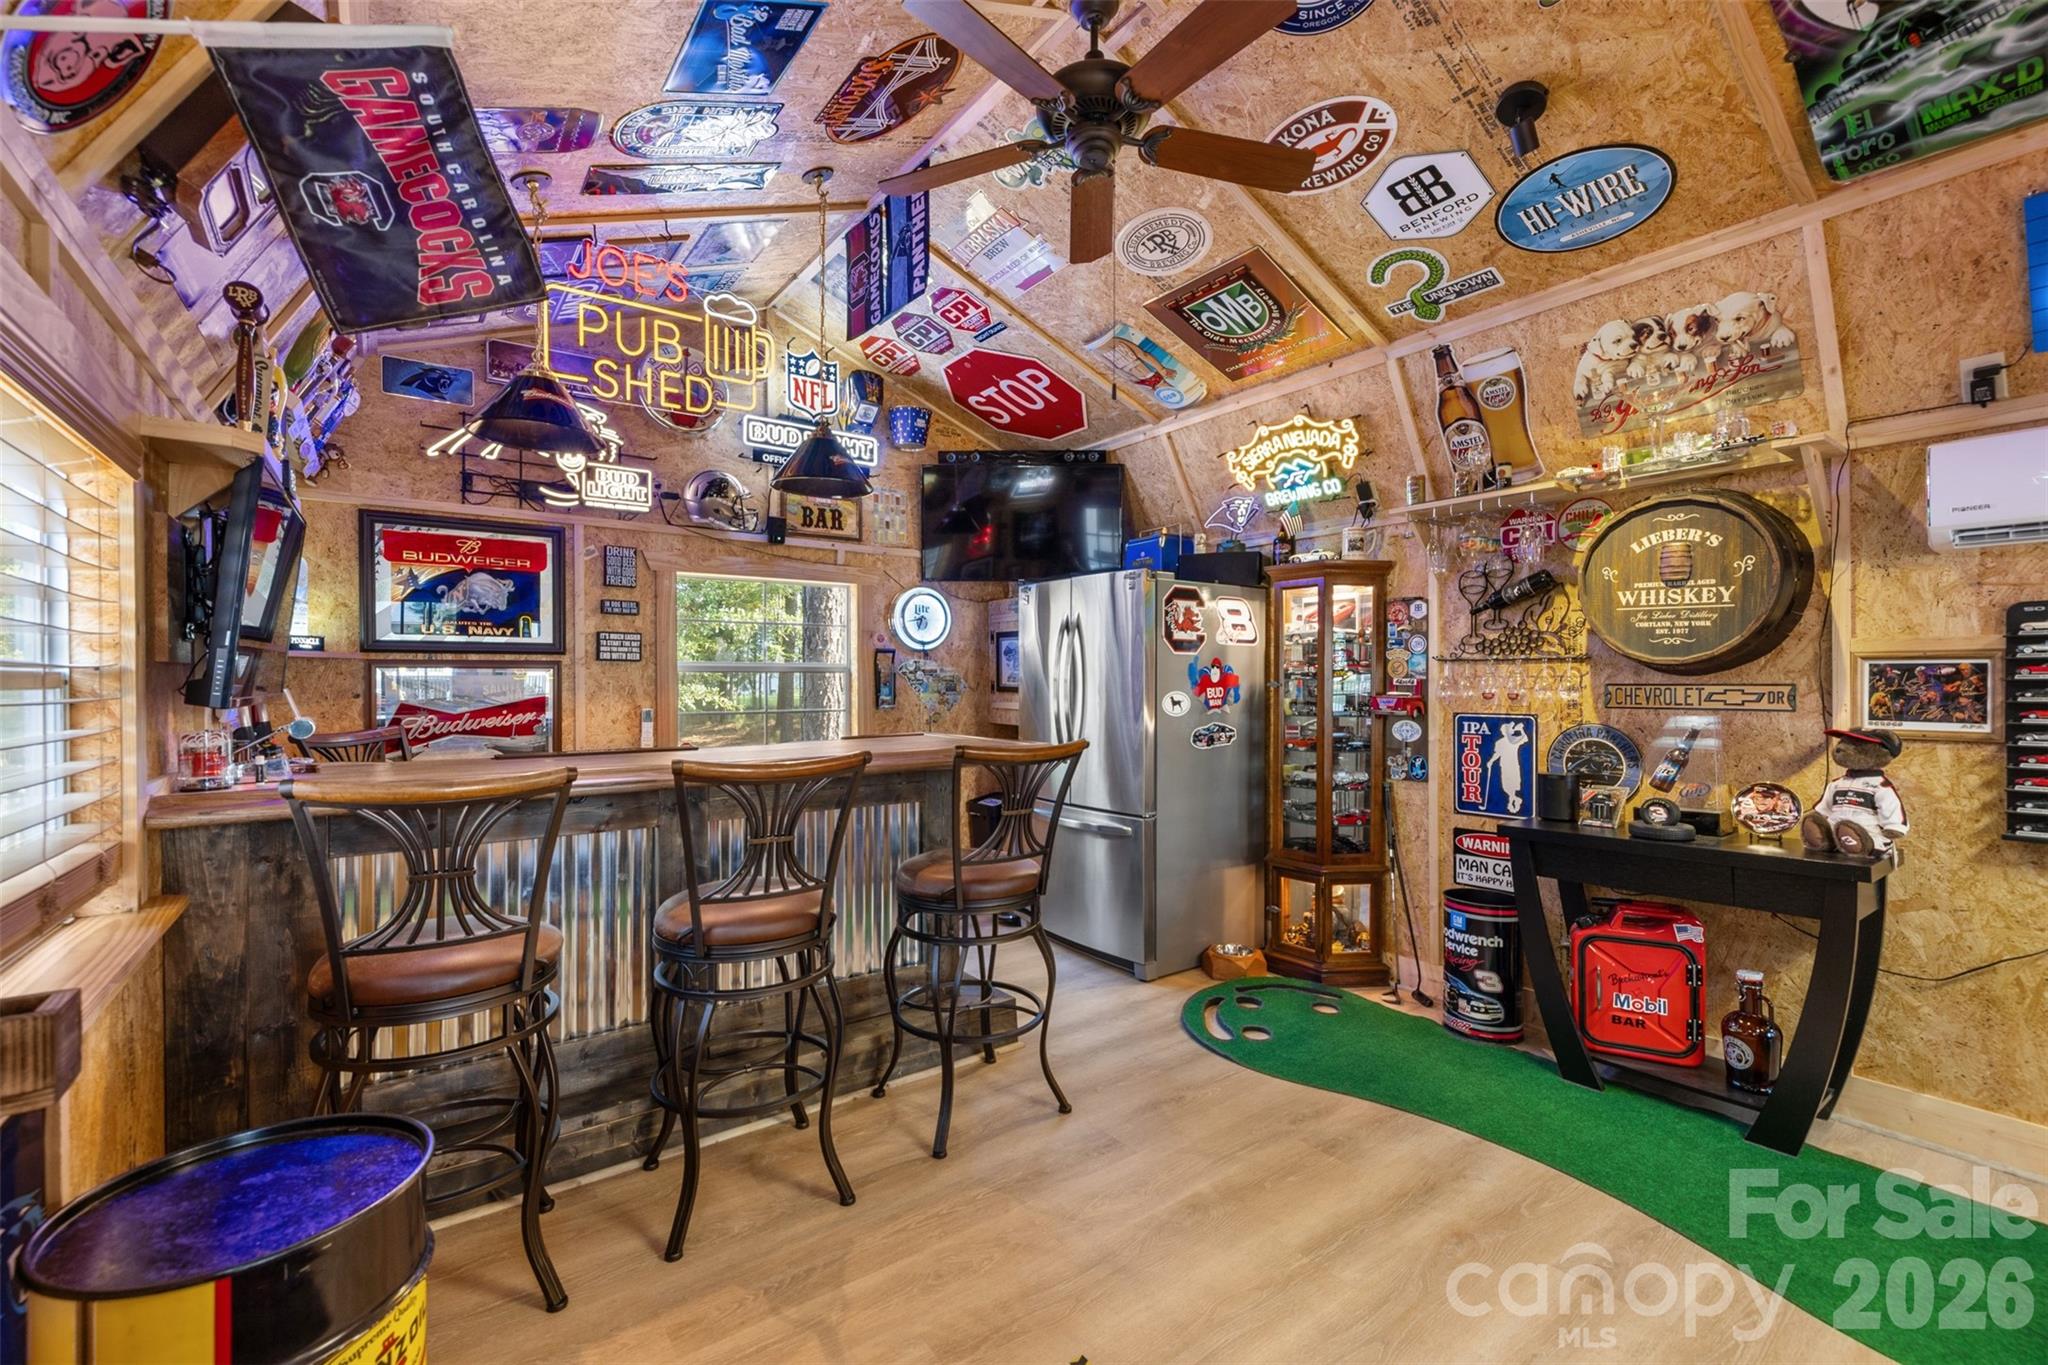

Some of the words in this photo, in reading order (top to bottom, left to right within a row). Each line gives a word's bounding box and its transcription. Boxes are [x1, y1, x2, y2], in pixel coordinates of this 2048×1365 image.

[1298, 1, 1346, 20] SINCE
[1302, 14, 1340, 28] OREGON
[1918, 56, 2046, 125] MAX-D
[1278, 108, 1337, 148] KONA
[412, 72, 453, 153] SOUTH
[446, 163, 512, 286] CAROLINA
[1301, 154, 1367, 188] REWING
[320, 67, 495, 306] GAMECOCKS
[1517, 164, 1648, 236] HI-WIRE
[1400, 193, 1479, 233] BENFORD
[1415, 206, 1473, 234] BREWING
[983, 238, 1010, 261] BREW
[567, 239, 689, 302] JOE'S
[869, 212, 882, 326] GAMECOCKS
[1424, 271, 1495, 302] UNKNOWN
[939, 296, 984, 324] CPI
[1200, 292, 1263, 335] OMB
[1391, 301, 1416, 315] THE
[578, 302, 684, 365] PUB
[902, 321, 945, 350] CPI
[1203, 331, 1226, 343] Olde
[871, 345, 909, 368] CPI
[592, 359, 714, 413] SHED
[792, 377, 834, 416] NFL
[967, 367, 1059, 424] STOP
[748, 422, 802, 447] BUD
[1451, 436, 1483, 449] AMSTEL
[762, 453, 789, 464] OFFIC
[1242, 435, 1286, 471] SIERRA
[1283, 429, 1342, 450] NEVADA
[595, 466, 640, 487] BUD
[587, 480, 648, 503] LIGHT
[1265, 484, 1322, 508] BREWING
[1324, 479, 1343, 494] CO
[801, 504, 844, 532] BAR
[606, 546, 637, 558] DRINK
[1630, 528, 1724, 554] LIEBER'S
[402, 550, 532, 569] BUDWEISER
[606, 576, 637, 587] FRIENDS
[1616, 586, 1736, 607] WHISKEY
[914, 604, 931, 615] Lite
[1680, 610, 1719, 621] Distillery
[420, 624, 460, 636] U.S.
[468, 624, 515, 637] NAVY
[1635, 620, 1673, 628] CORTLAND,
[1691, 619, 1712, 627] YORK
[1206, 687, 1224, 699] BUD
[1614, 686, 1705, 707] CHEVROLET
[1767, 690, 1785, 705] DR
[401, 709, 543, 740] Budweiser
[1462, 721, 1491, 735] IPA
[1461, 735, 1482, 803] TOUR
[1462, 836, 1509, 855] WARNI
[1458, 857, 1489, 873] MAN
[1493, 862, 1512, 877] CA
[1458, 871, 1474, 881] IT'S
[1475, 874, 1504, 887] HAPPY
[1613, 991, 1668, 1016] Mobil
[1611, 1014, 1647, 1029] BAR
